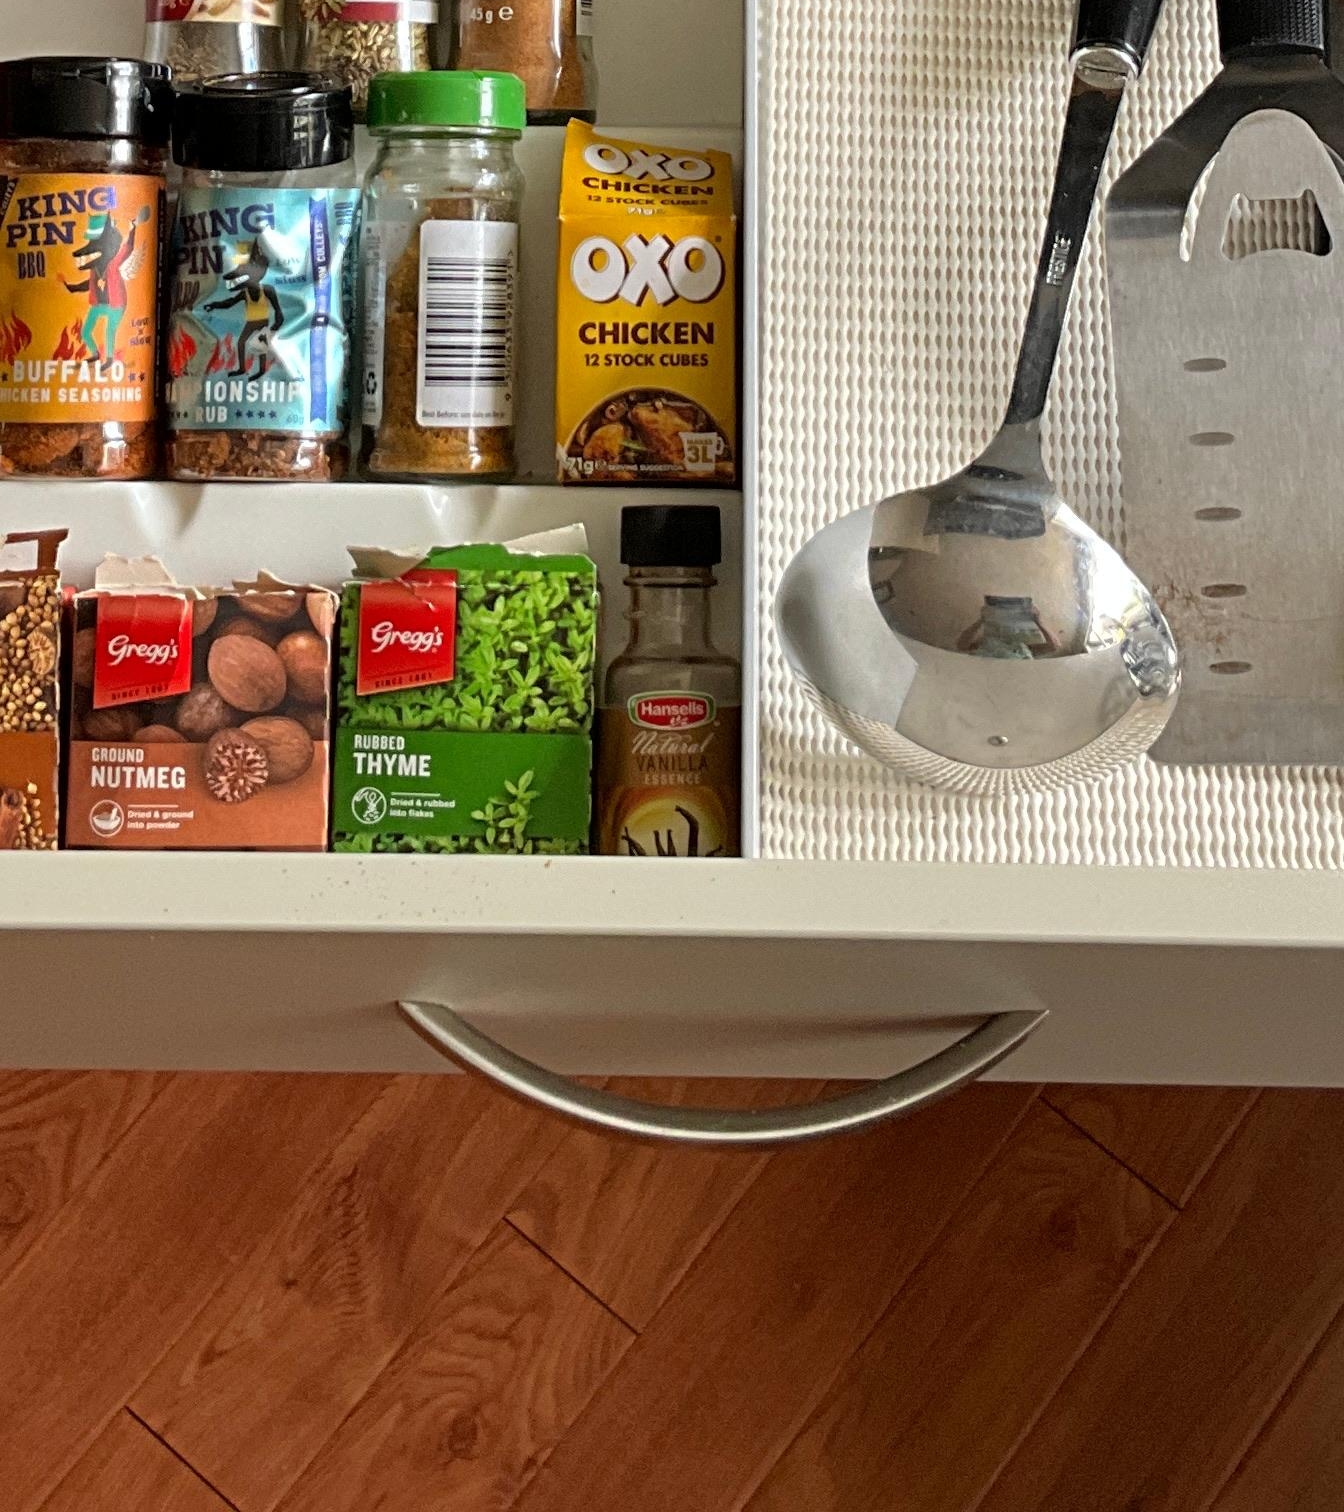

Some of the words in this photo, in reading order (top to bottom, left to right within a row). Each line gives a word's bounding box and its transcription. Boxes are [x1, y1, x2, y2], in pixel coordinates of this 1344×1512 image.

[470, 7, 483, 21] 45
[485, 9, 493, 24] g
[584, 143, 715, 182] OXO
[582, 177, 714, 196] CHICKEN
[17, 185, 118, 222] KING
[587, 194, 602, 202] 12
[606, 197, 655, 205] STOCK
[180, 203, 275, 242] KING
[6, 221, 76, 248] PIN
[17, 251, 46, 280] BBQ
[175, 245, 227, 275] PIN
[572, 233, 726, 307] OXO
[578, 321, 715, 345] CHICKEN
[584, 354, 600, 366] 12
[604, 354, 655, 367] STOCK
[659, 354, 709, 367] CUBES
[13, 359, 125, 384] BUFFALO
[58, 386, 142, 403] SEASONING
[195, 406, 228, 423] RUB
[686, 445, 713, 464] 3L
[566, 456, 594, 475] 71g
[371, 621, 444, 653] Gregg's
[107, 634, 179, 666] Gregg's
[641, 701, 705, 717] Hansells
[354, 734, 405, 751] RUBBED
[632, 730, 715, 756] Natural
[91, 747, 145, 763] GROUND
[353, 752, 432, 777] THYME
[636, 754, 708, 772] VANILLA
[91, 765, 186, 789] NUTMEG
[644, 773, 701, 785] ESSENCE
[389, 797, 414, 806] Dried
[423, 799, 456, 808] rubbed
[127, 810, 152, 819] Dried
[162, 810, 194, 820] ground
[146, 822, 181, 830] powder
